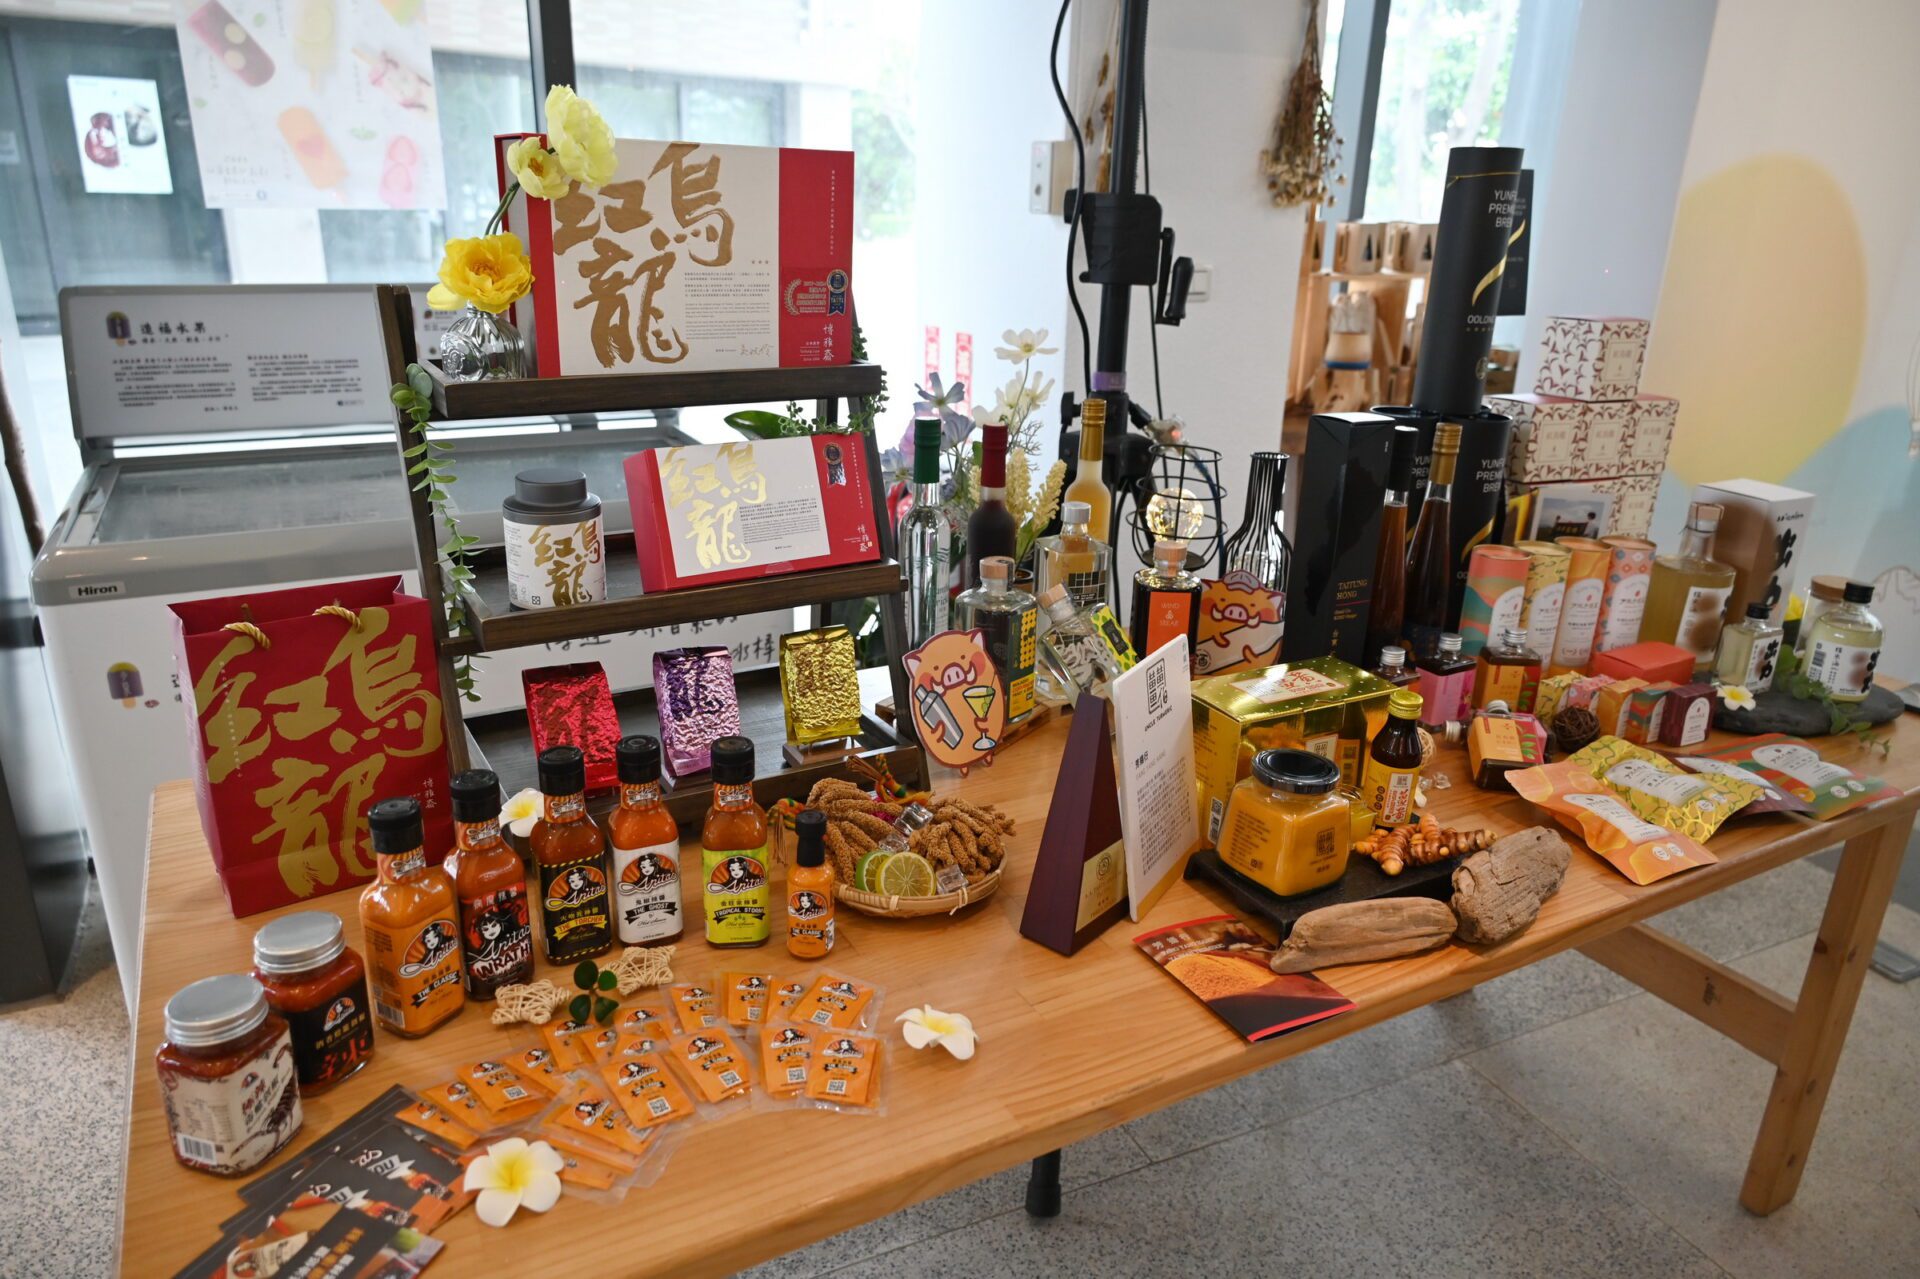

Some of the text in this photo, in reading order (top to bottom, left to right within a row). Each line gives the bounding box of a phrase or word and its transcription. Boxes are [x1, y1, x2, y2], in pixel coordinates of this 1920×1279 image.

[77, 584, 118, 597] Hiron
[1144, 717, 1156, 732] UNCLE
[633, 902, 669, 914] THE GHOST
[716, 907, 741, 917] TROPICAL
[477, 941, 531, 978] WRATH
[417, 988, 431, 999] THE
[433, 972, 458, 988] CLASSIC
